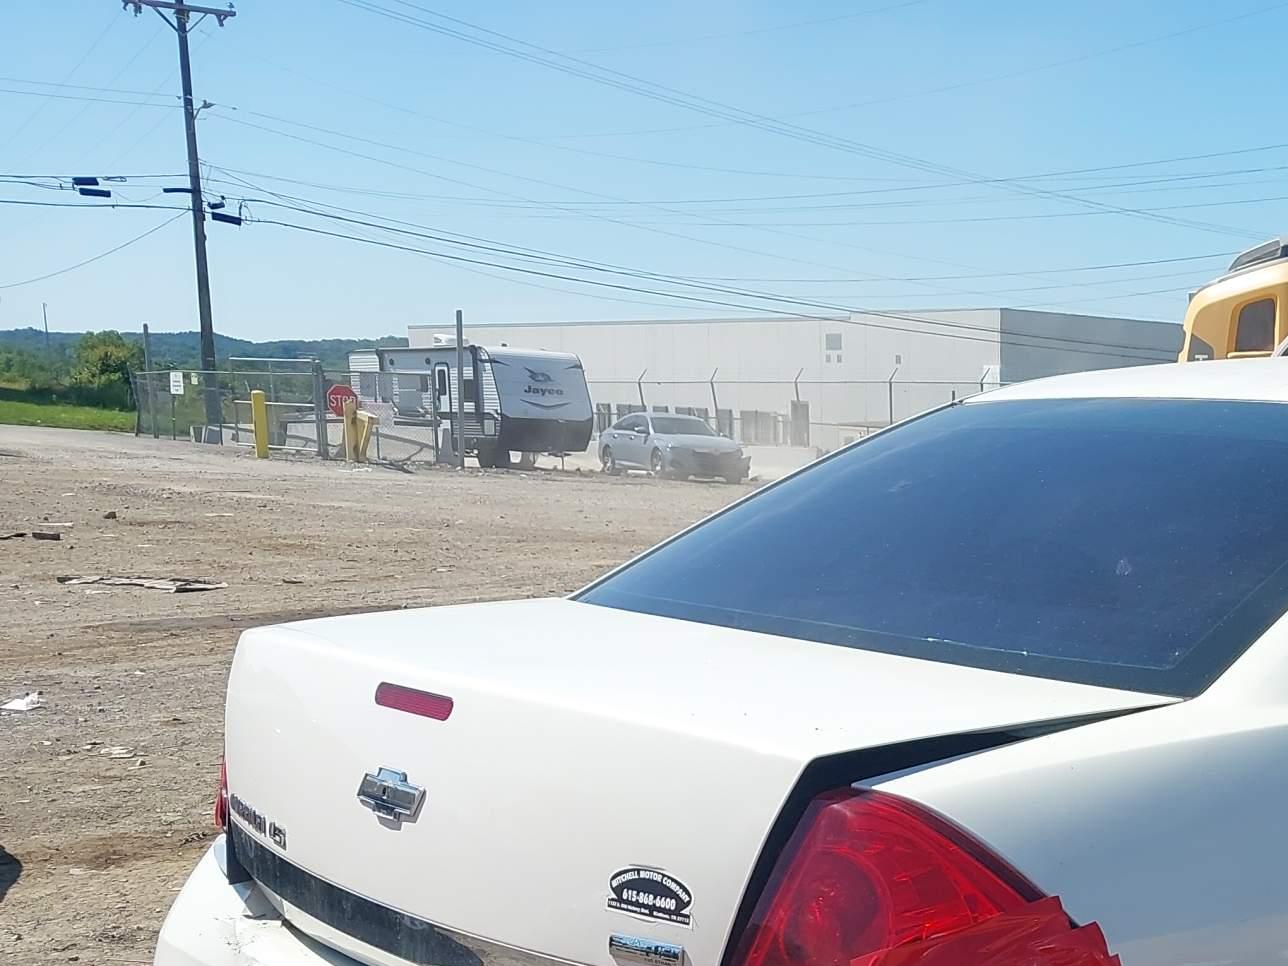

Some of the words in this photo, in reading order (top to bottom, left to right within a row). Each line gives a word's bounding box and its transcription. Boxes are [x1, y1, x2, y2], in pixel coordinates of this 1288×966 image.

[524, 385, 564, 396] Jayco
[611, 870, 639, 888] MITCHELL
[640, 870, 662, 882] MOTOR
[662, 877, 690, 903] COMPANY
[622, 888, 677, 910] 615-868-6600
